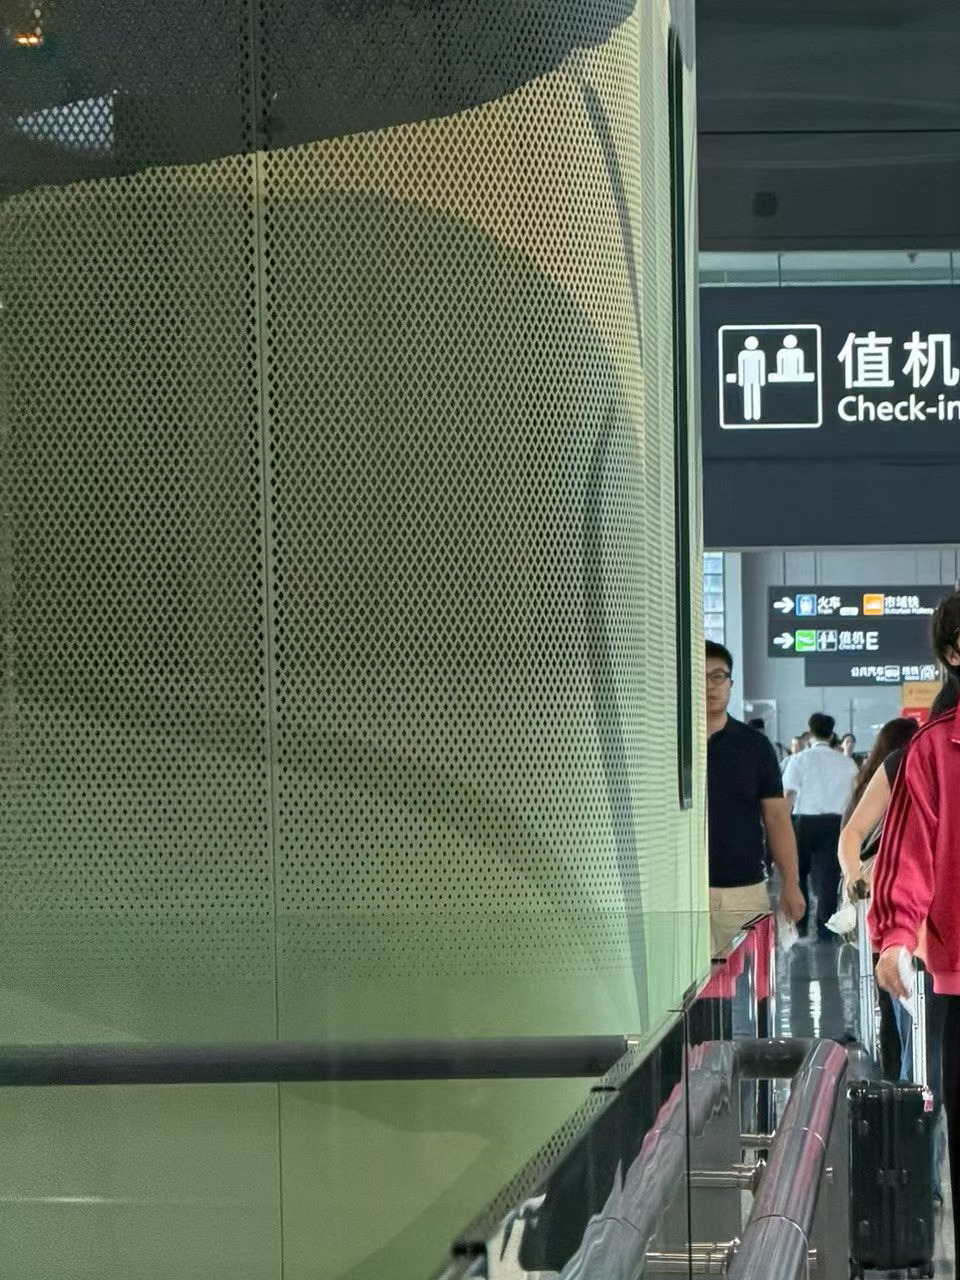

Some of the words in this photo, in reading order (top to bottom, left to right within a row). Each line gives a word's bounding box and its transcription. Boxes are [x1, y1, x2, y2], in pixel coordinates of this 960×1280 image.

[837, 331, 960, 390] 值机
[817, 596, 841, 608] 火车
[839, 631, 865, 644] 值机
[866, 631, 879, 650] E
